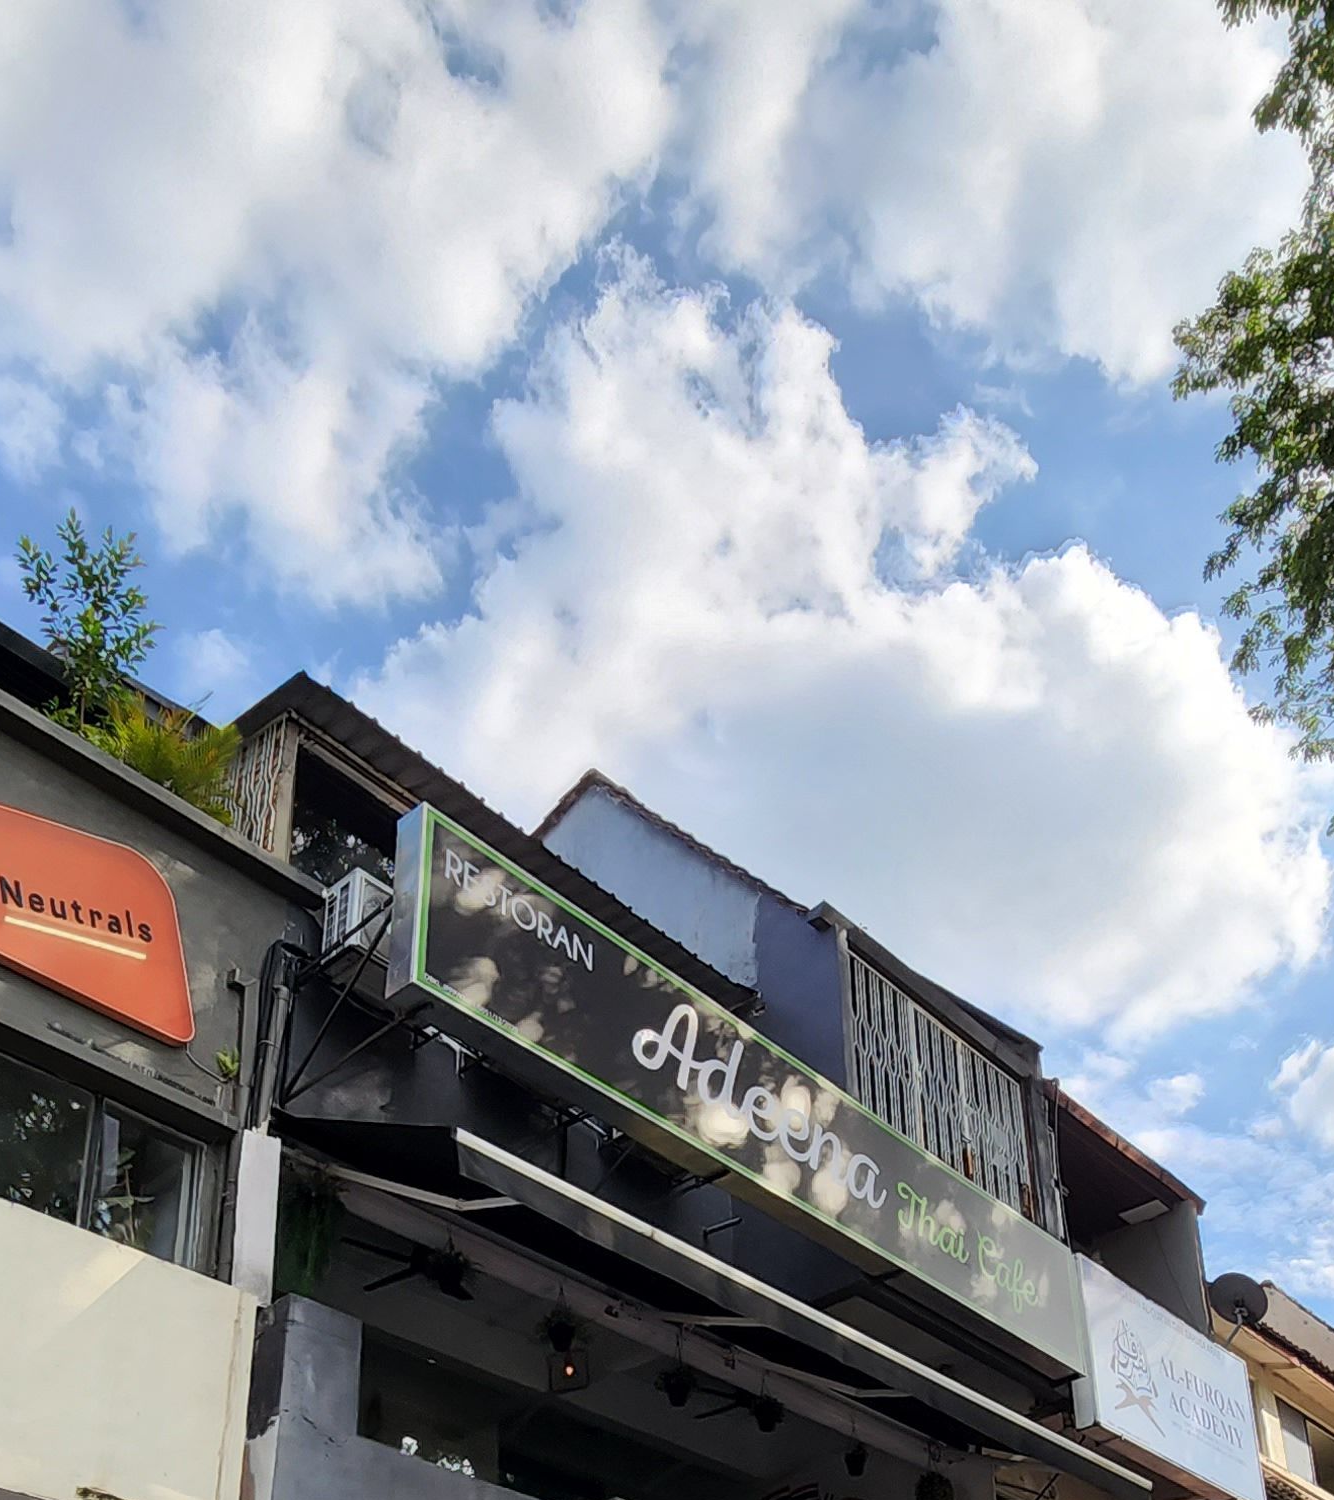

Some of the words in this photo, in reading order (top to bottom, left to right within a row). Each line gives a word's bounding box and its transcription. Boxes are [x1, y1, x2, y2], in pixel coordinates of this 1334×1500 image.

[0, 875, 152, 942] Neutrals
[443, 849, 594, 972] RESTORAN
[632, 1004, 887, 1209] Adeena
[897, 1182, 969, 1264] Thai
[976, 1229, 1038, 1313] Cafe
[1160, 1356, 1246, 1422] AL-FURQAN
[1169, 1391, 1244, 1449] ACADEMY
